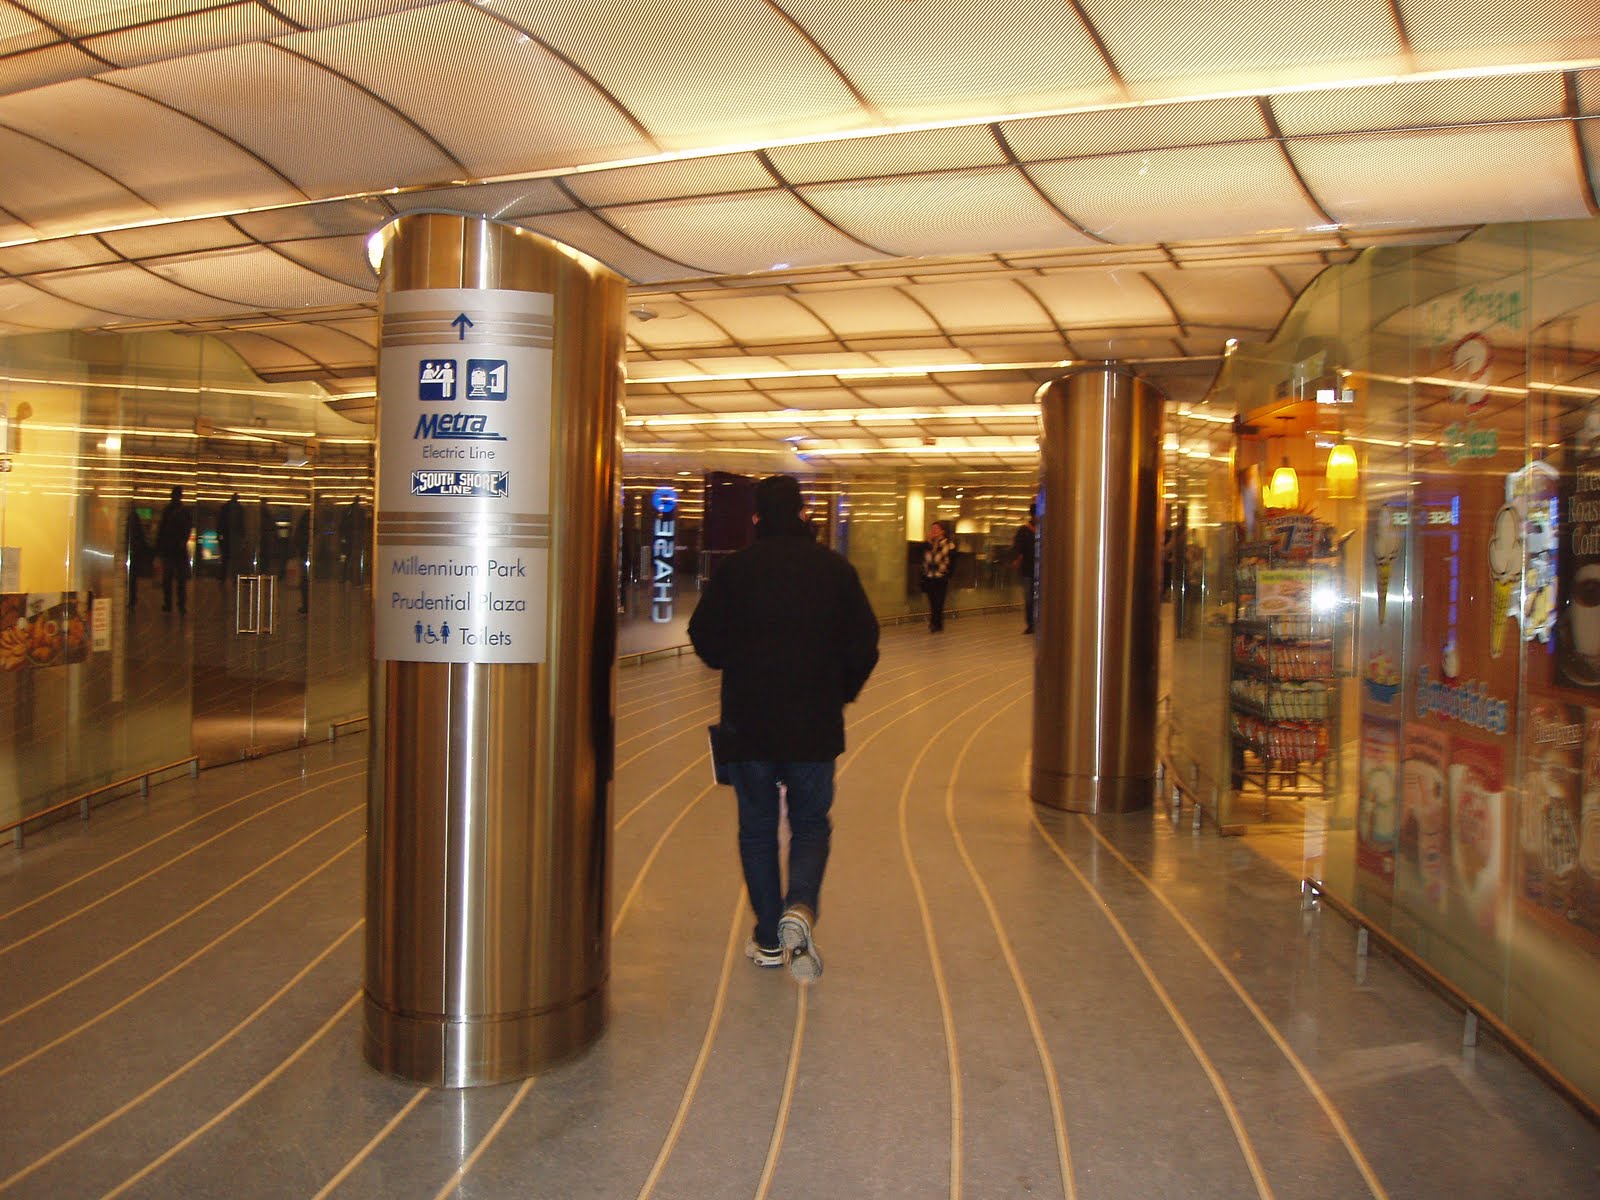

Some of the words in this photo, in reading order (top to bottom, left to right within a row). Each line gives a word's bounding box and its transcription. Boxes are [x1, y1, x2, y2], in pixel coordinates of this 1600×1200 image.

[413, 411, 490, 440] Metra
[422, 444, 465, 459] Electric
[469, 446, 496, 460] Line
[419, 472, 456, 492] SOUTH
[459, 473, 499, 494] SHORE
[440, 485, 473, 494] LINE
[1568, 496, 1600, 523] Roas
[391, 556, 480, 577] Millennium
[487, 558, 527, 577] Park
[391, 591, 471, 612] Prudential
[480, 591, 526, 612] Plaza
